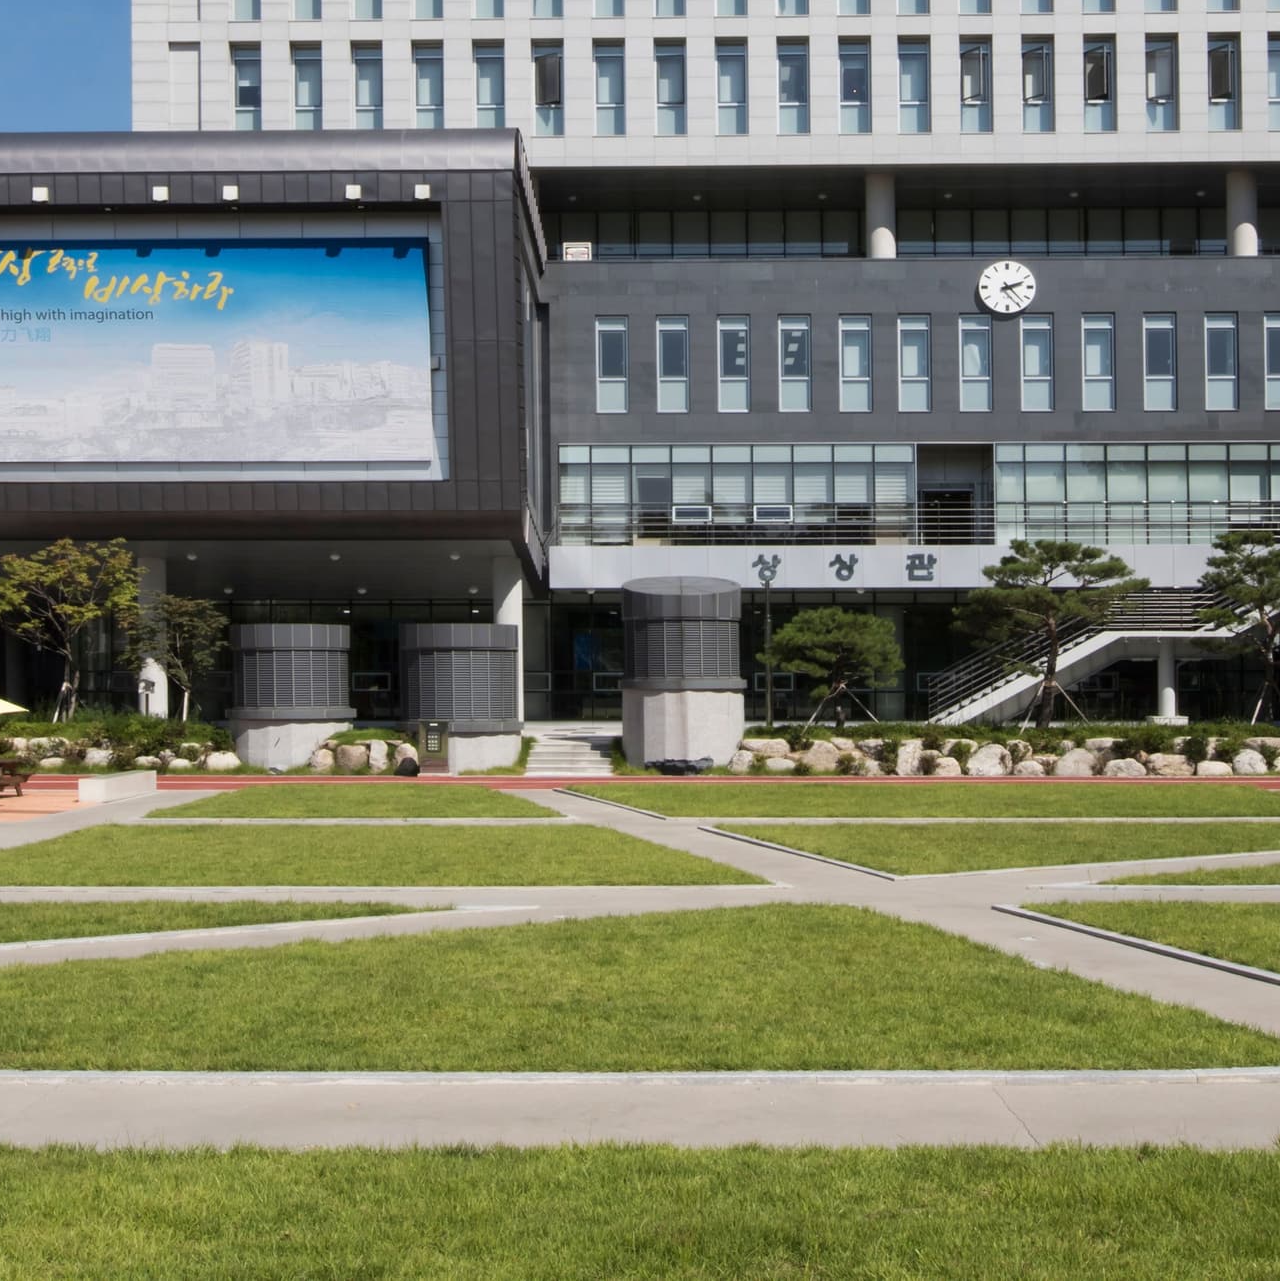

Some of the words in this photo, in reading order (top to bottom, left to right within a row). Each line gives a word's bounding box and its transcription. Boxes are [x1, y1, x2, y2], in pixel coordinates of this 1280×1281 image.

[84, 271, 234, 311] 비상하라
[0, 308, 32, 324] high
[35, 308, 66, 321] with
[70, 308, 154, 324] imagination
[751, 553, 938, 582] 상상관
